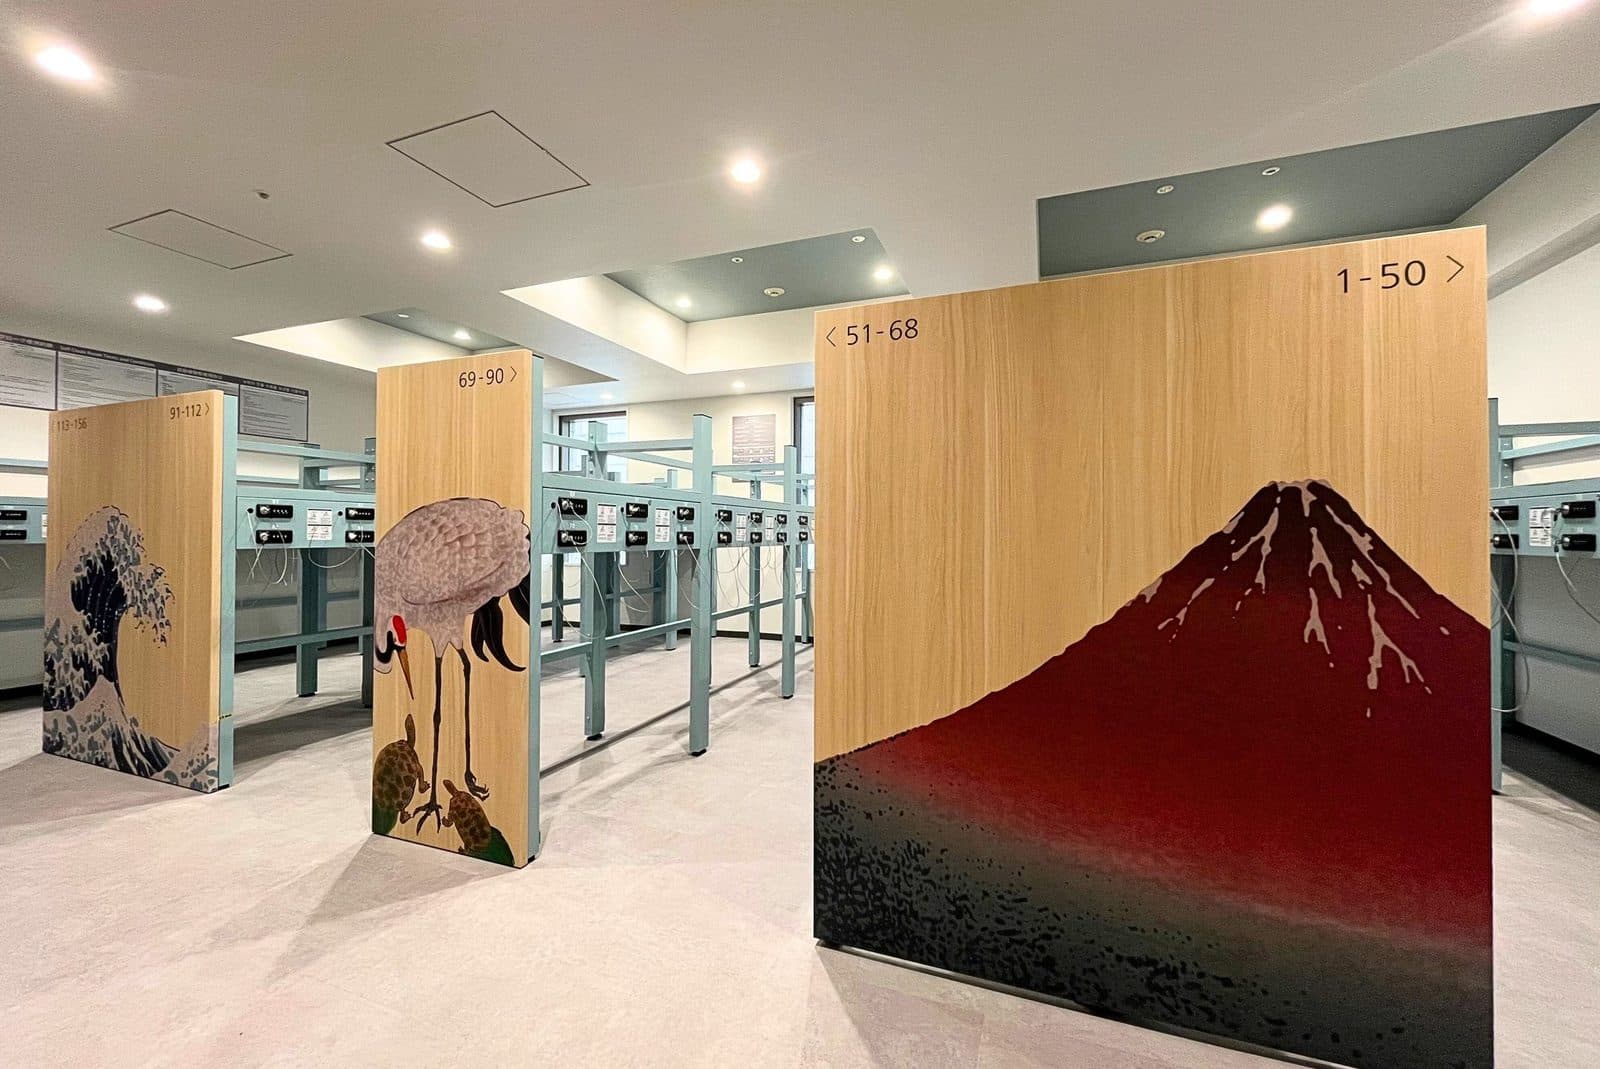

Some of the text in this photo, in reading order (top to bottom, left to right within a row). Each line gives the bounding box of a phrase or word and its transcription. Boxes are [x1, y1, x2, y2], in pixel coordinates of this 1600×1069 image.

[1337, 260, 1426, 294] 1-50
[847, 318, 919, 346] 51-68
[458, 367, 504, 388] 69-90
[169, 403, 202, 420] 91-112
[57, 417, 89, 432] 113-156
